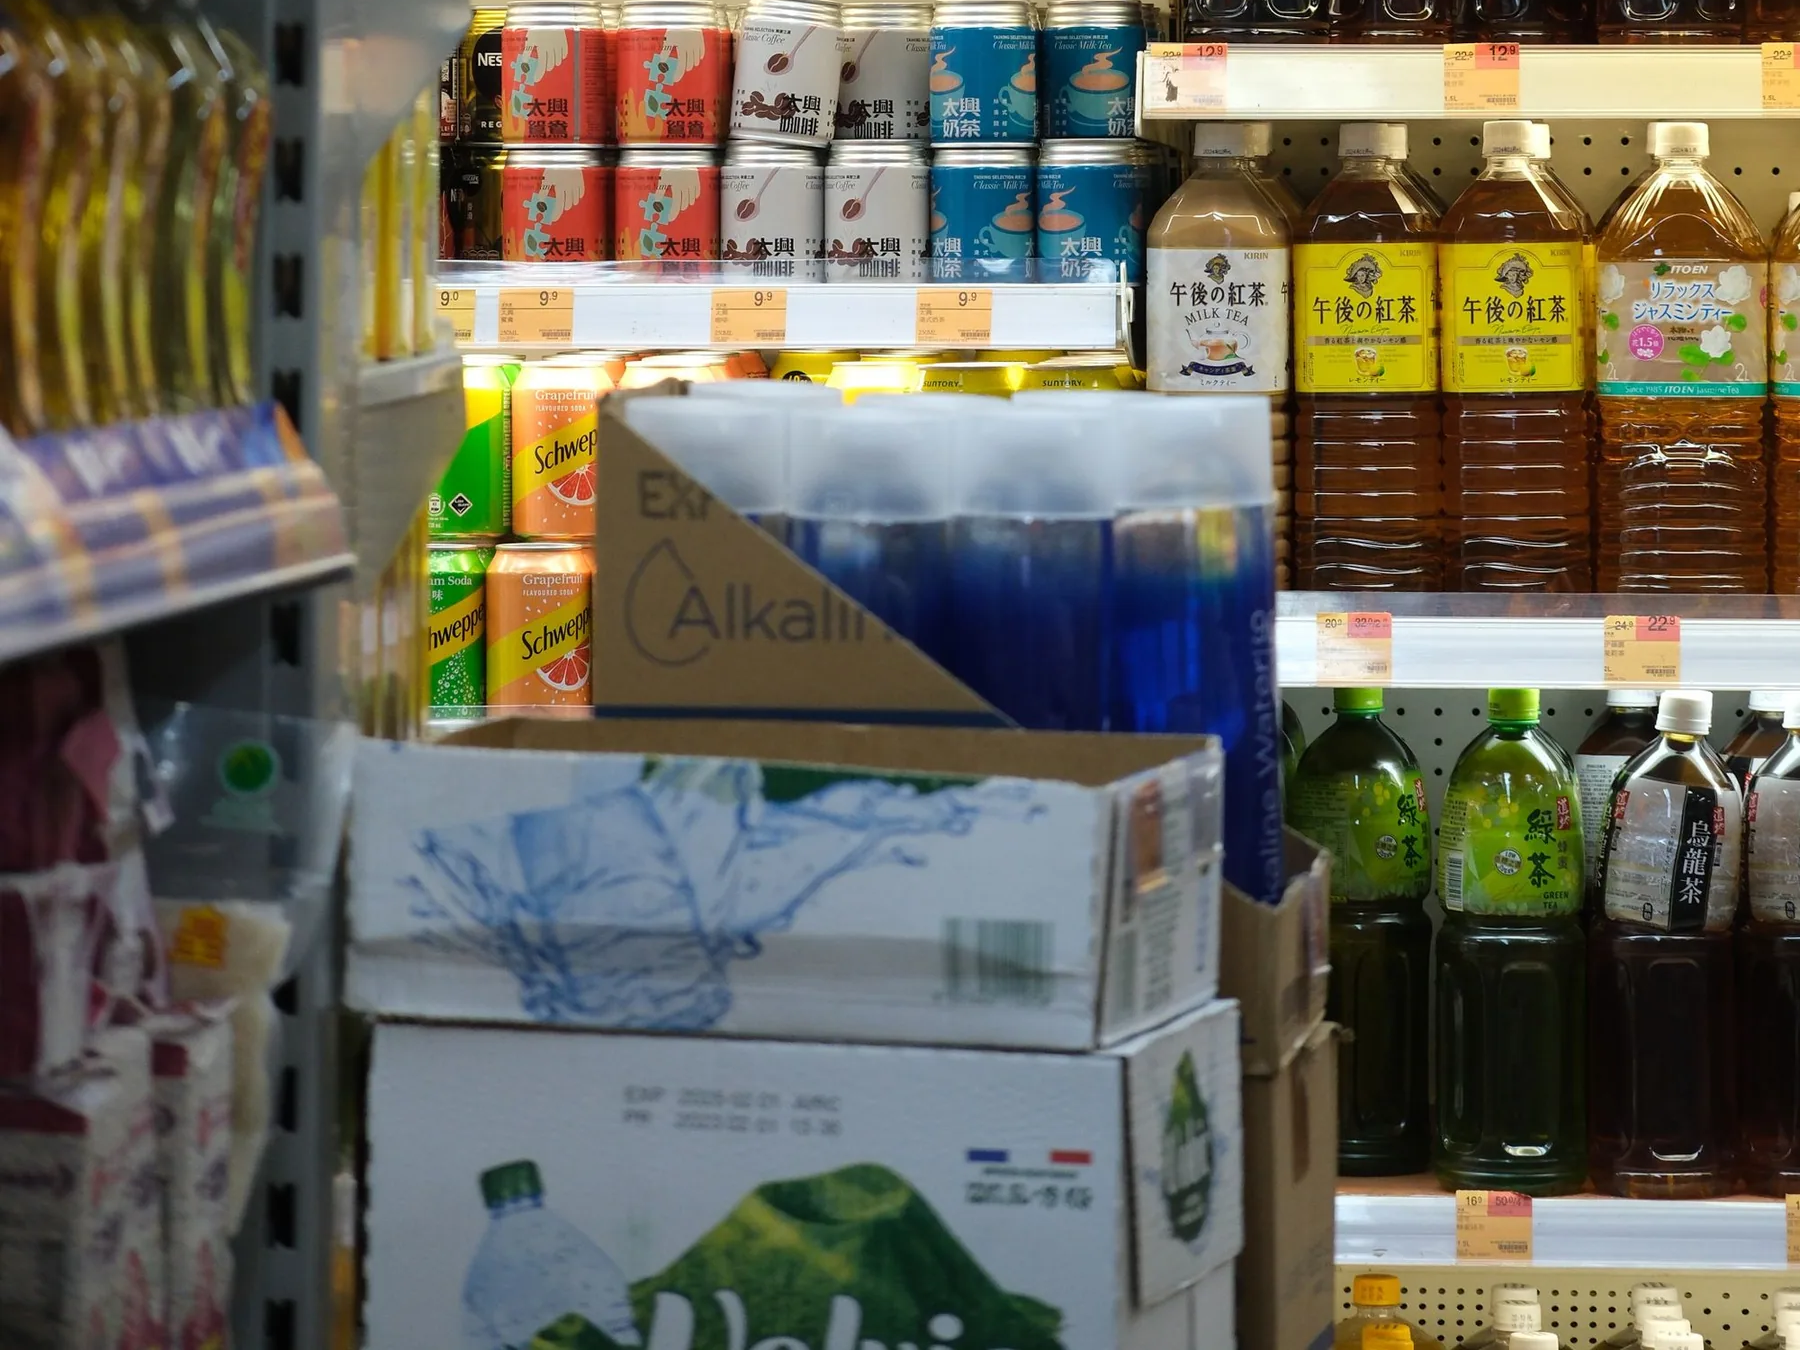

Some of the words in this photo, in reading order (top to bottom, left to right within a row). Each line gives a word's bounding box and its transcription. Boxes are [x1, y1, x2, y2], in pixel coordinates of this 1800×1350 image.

[761, 32, 786, 45] Coffee
[993, 40, 1019, 50] Classic
[1079, 40, 1097, 50] Milk
[1098, 40, 1112, 50] Tea
[527, 97, 568, 117] 太興
[665, 97, 705, 117] 太興
[785, 93, 821, 116] 太興
[858, 98, 894, 119] 太興
[943, 97, 981, 117] 太興
[943, 118, 981, 138] 奶茶
[973, 180, 1001, 190] Classic
[1003, 180, 1019, 190] Milk
[1052, 180, 1065, 190] Tea
[543, 237, 584, 256] 太興
[660, 237, 700, 256] 太興
[757, 238, 795, 256] 太興
[863, 238, 901, 256] 太興
[933, 237, 962, 256] 太興
[1060, 237, 1103, 256] 太興
[1243, 252, 1269, 260] KIRIN
[933, 258, 961, 278] 奶茶
[440, 291, 459, 307] 9.0
[540, 290, 558, 307] 9.9
[754, 291, 773, 307] 9.9
[959, 291, 977, 307] 9.9
[1169, 281, 1266, 307] 午後の紅茶
[1651, 281, 1715, 299] リラックス
[1184, 307, 1220, 326] MILK
[1225, 308, 1249, 326] TEA
[1312, 295, 1416, 325] 午後の紅茶
[1462, 295, 1567, 325] 午後の紅茶
[1634, 303, 1732, 320] ジャスミンティー
[1735, 363, 1748, 381] 2L
[922, 379, 959, 388] SUNTORY
[1042, 379, 1083, 388] SUNTORY
[1625, 385, 1645, 394] Since
[448, 575, 472, 586] Soda
[1648, 616, 1676, 632] 22.9
[1524, 808, 1557, 888] 綠茶
[1679, 820, 1711, 905] 烏龍茶
[1543, 890, 1569, 899] GREEN
[1543, 901, 1558, 909] TEA
